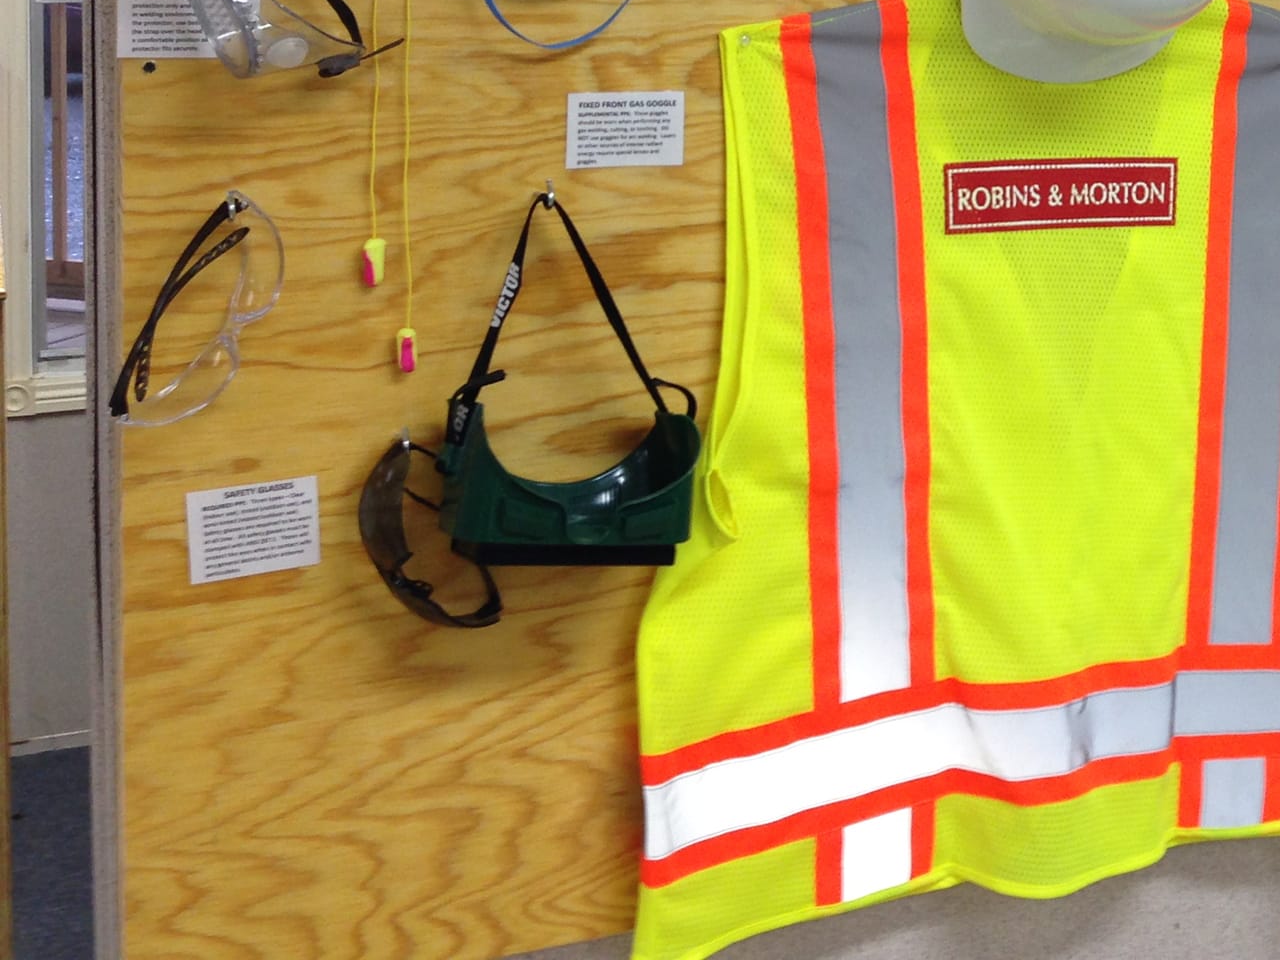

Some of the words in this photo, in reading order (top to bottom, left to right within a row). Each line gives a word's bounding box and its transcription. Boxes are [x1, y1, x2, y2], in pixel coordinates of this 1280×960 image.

[958, 184, 1041, 211] ROBINS
[1048, 184, 1063, 207] &
[1070, 181, 1166, 206] MORTON
[491, 262, 520, 328] VICTOR
[223, 488, 256, 499] SAFETY
[258, 482, 294, 494] GLASSES
